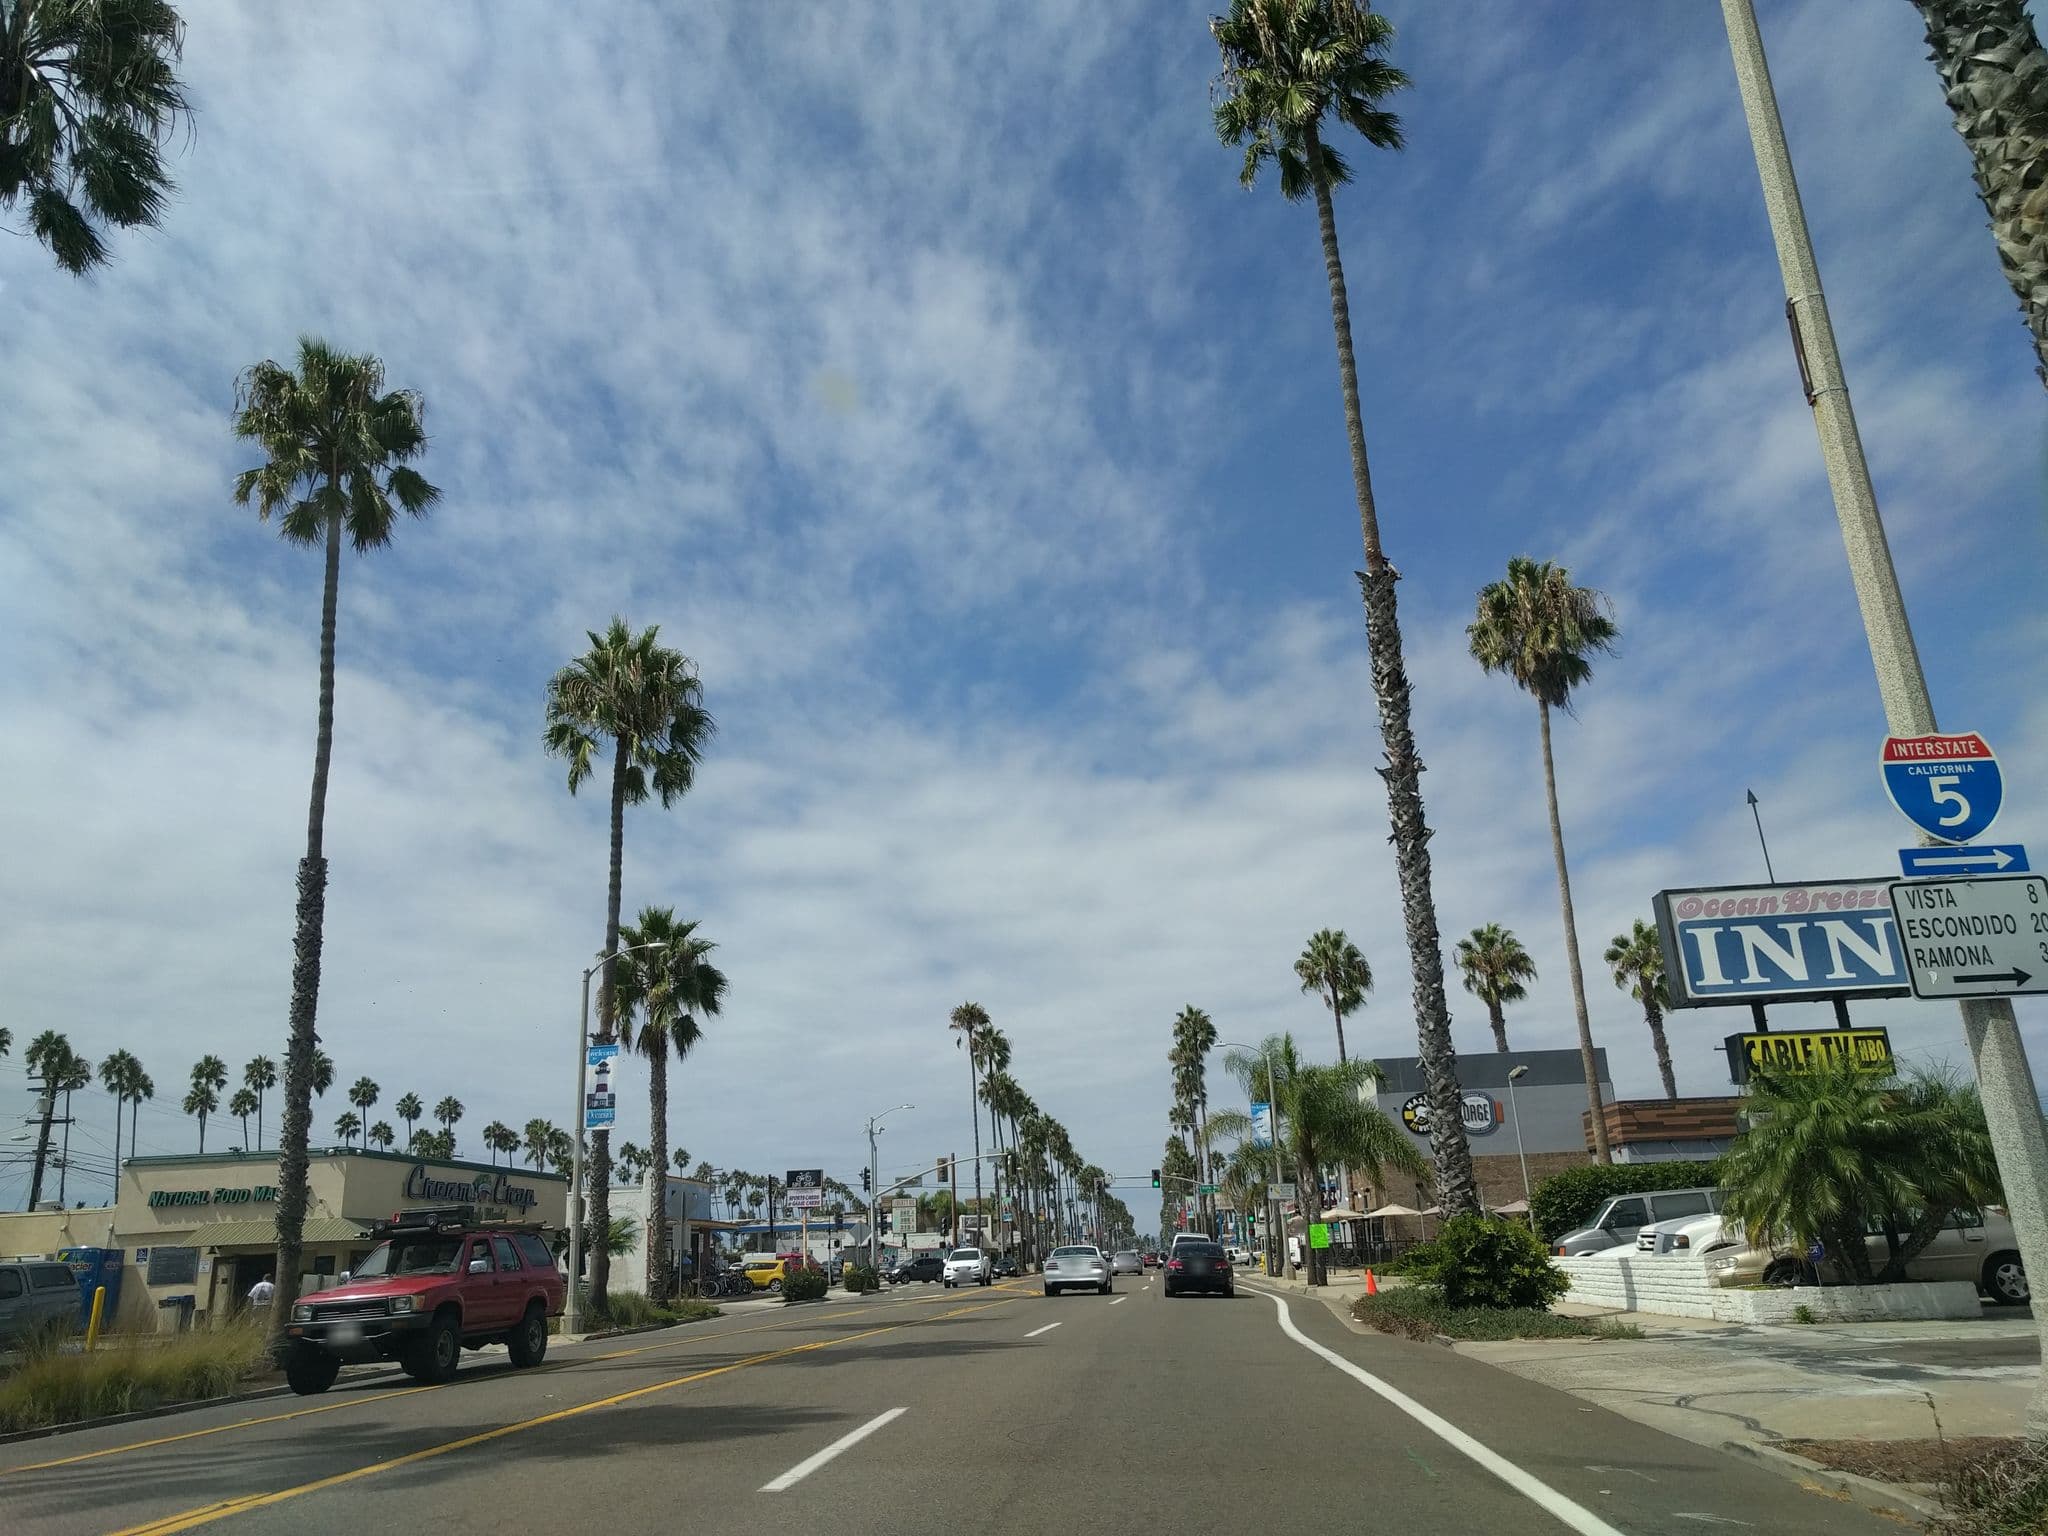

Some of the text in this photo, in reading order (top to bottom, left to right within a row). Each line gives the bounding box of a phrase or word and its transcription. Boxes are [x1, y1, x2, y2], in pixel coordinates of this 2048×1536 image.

[1892, 740, 1979, 757] INTERSTATE
[1908, 764, 1975, 775] CALIFORNIA
[1929, 776, 1970, 826] 5
[1677, 896, 1779, 919] Ocean
[1905, 883, 2038, 910] VISTA 8
[1906, 914, 2017, 938] ESCONDIDO
[1686, 917, 1897, 986] INN
[1914, 945, 1994, 968] RAMONA
[1745, 1035, 1887, 1073] CABLE TV HBO
[148, 1190, 210, 1208] NATURAL
[212, 1188, 252, 1205] FOOD
